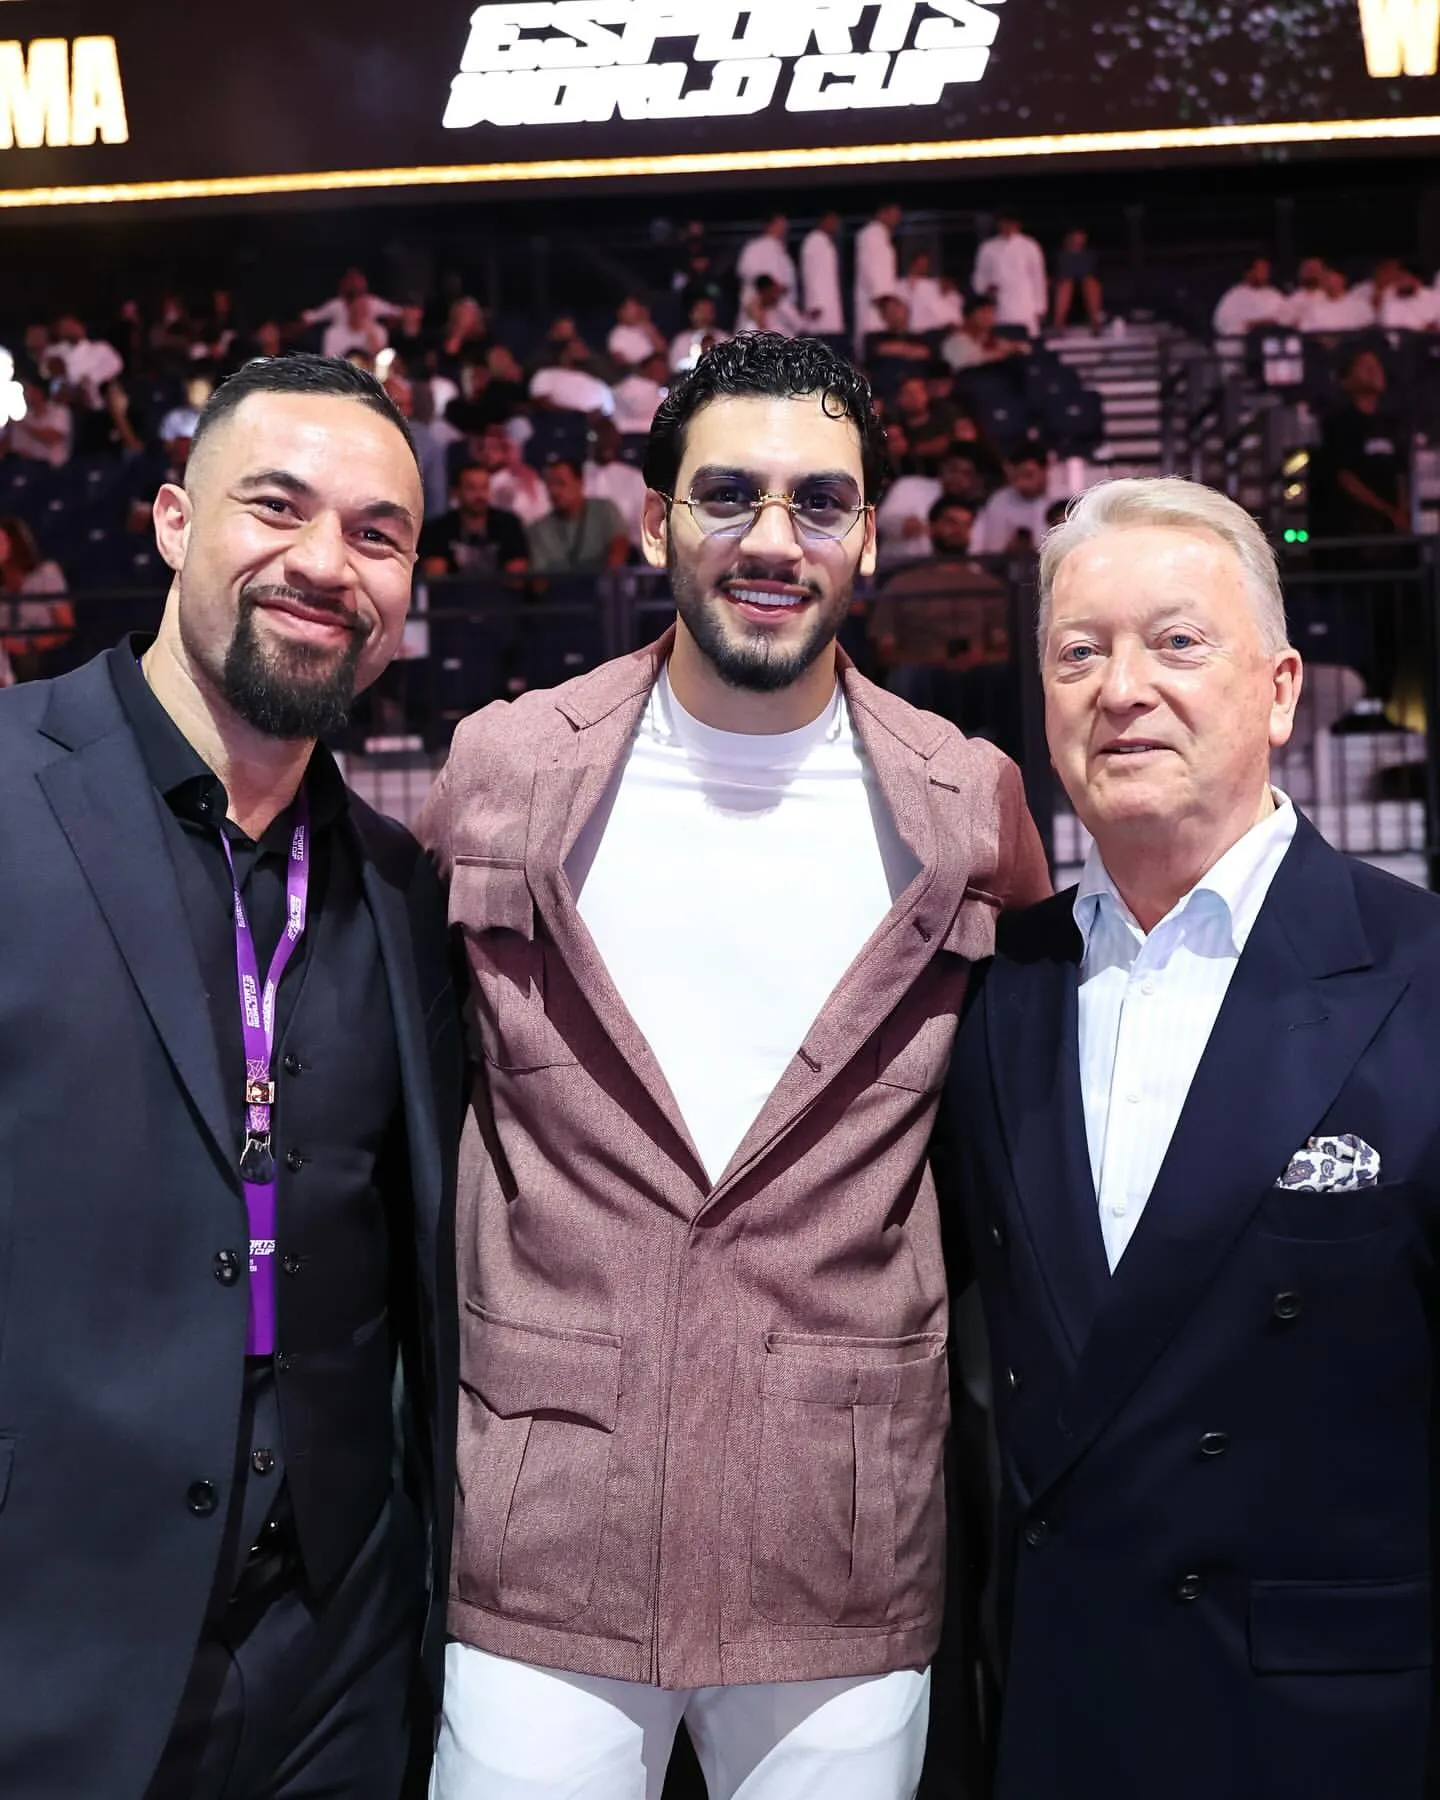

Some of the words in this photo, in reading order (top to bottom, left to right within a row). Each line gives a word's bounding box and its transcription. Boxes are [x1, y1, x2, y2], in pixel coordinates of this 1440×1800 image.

[460, 0, 1007, 72] ESPORTS
[442, 57, 782, 128] WORLD
[785, 47, 991, 112] CUP
